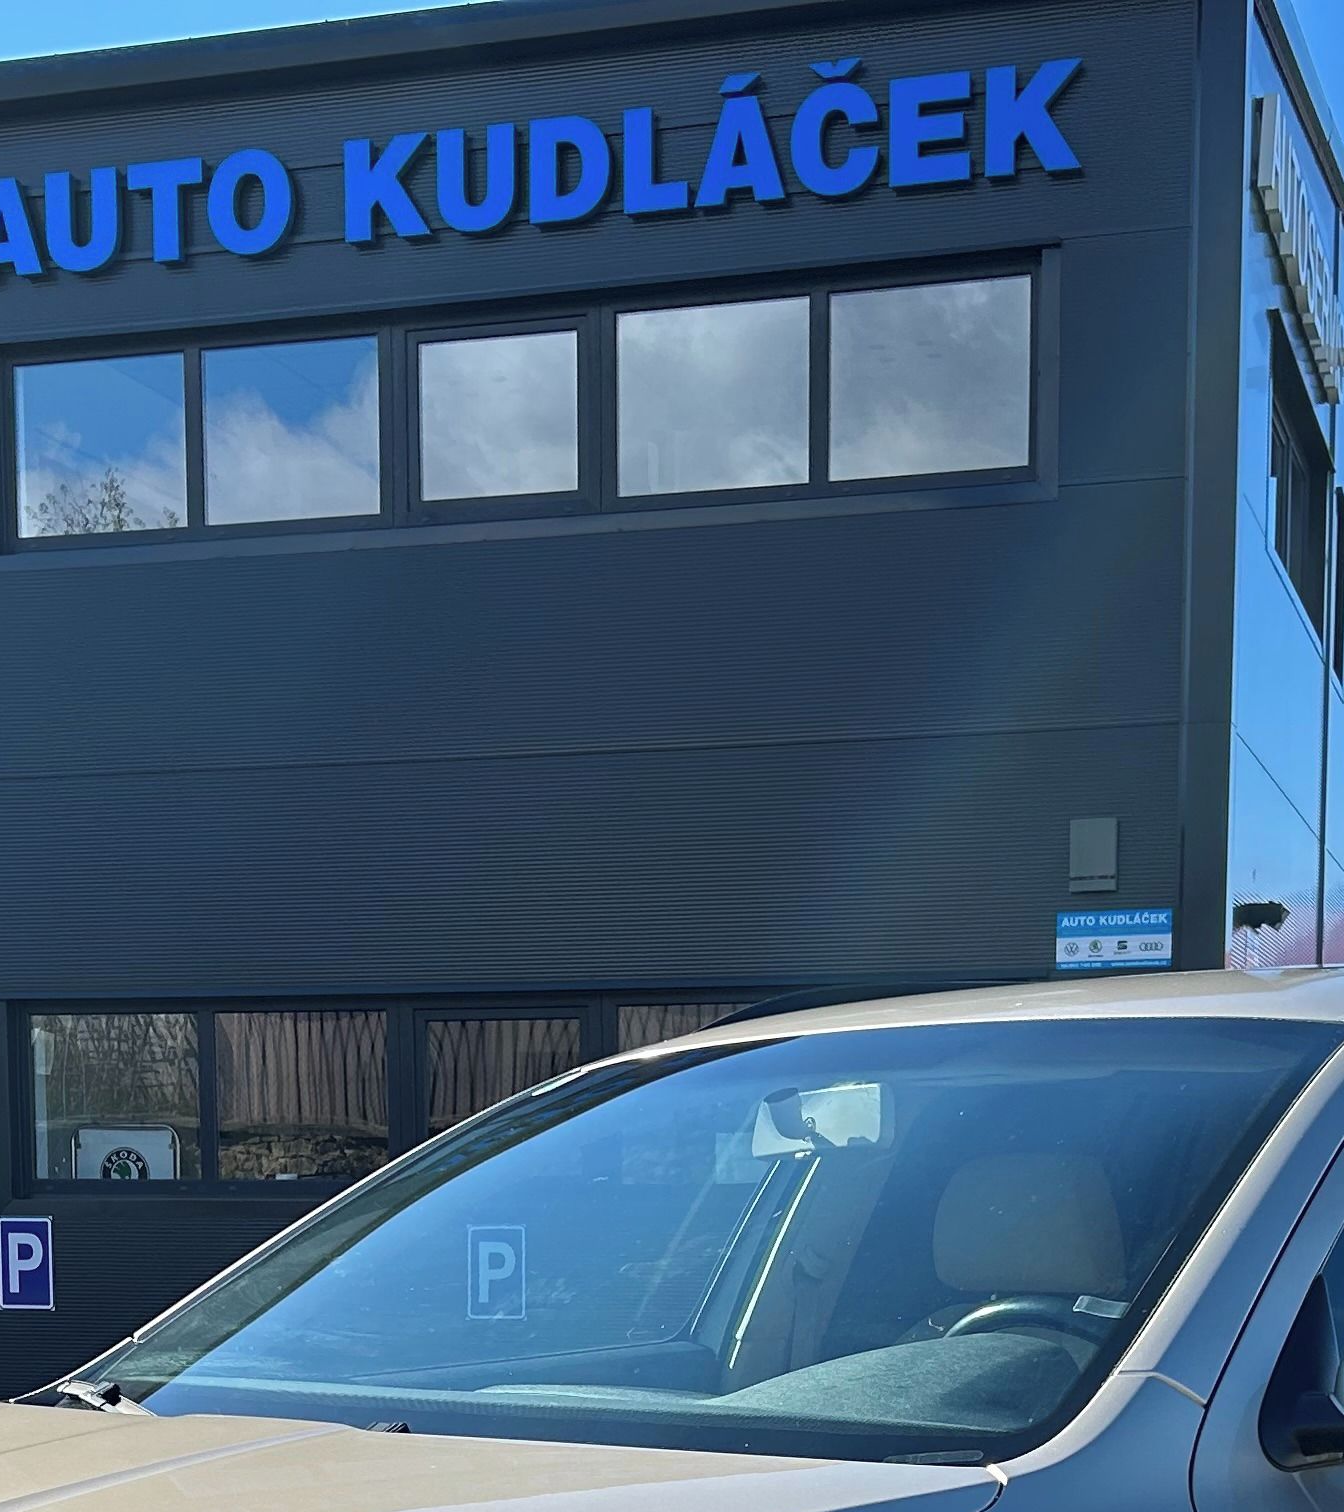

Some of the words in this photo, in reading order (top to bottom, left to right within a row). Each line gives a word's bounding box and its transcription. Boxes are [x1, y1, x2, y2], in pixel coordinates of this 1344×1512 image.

[343, 57, 1083, 244] KUDLÁČEK
[1061, 915, 1096, 928] AUTO
[1099, 912, 1168, 926] KUDLÁČEK
[7, 1231, 44, 1294] P
